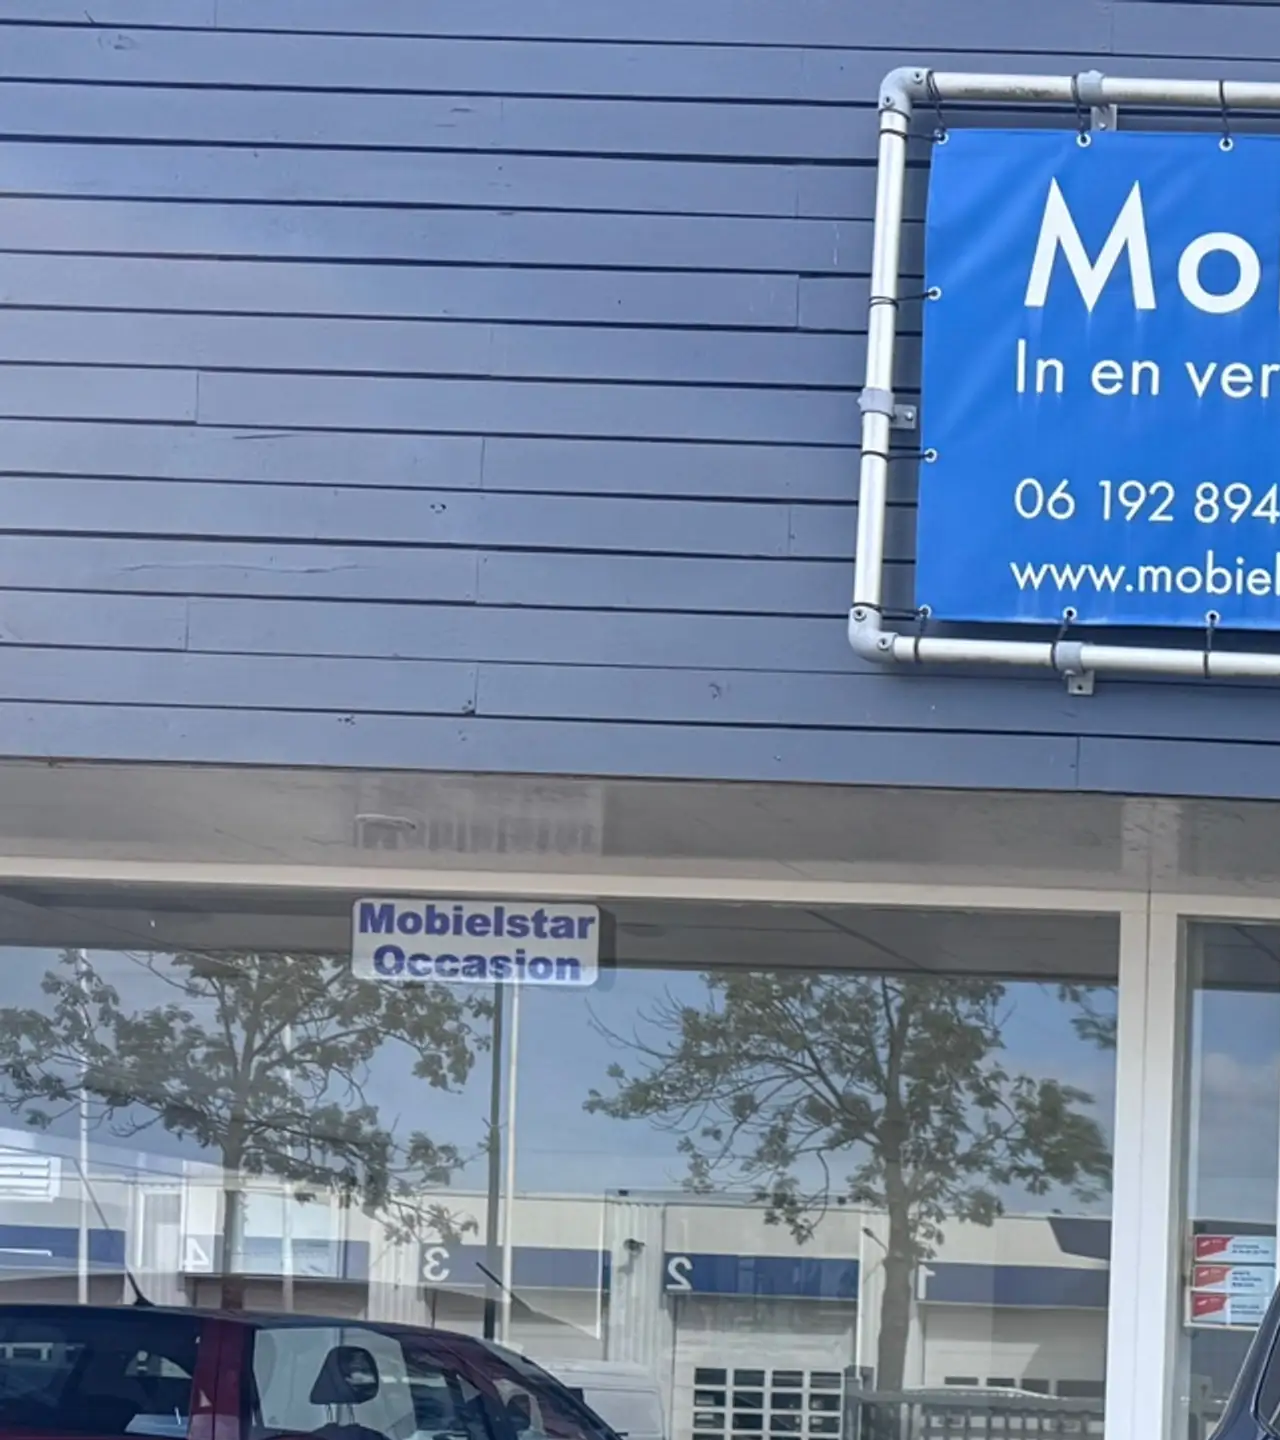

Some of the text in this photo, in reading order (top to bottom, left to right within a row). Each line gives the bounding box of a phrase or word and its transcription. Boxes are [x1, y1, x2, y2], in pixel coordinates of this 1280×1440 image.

[1016, 339, 1064, 393] In
[1091, 359, 1160, 396] en
[1014, 478, 1075, 520] 06
[1099, 480, 1175, 522] 192
[1194, 481, 1280, 526] 894
[359, 902, 596, 939] Mobielstar
[373, 944, 581, 981] Occasion
